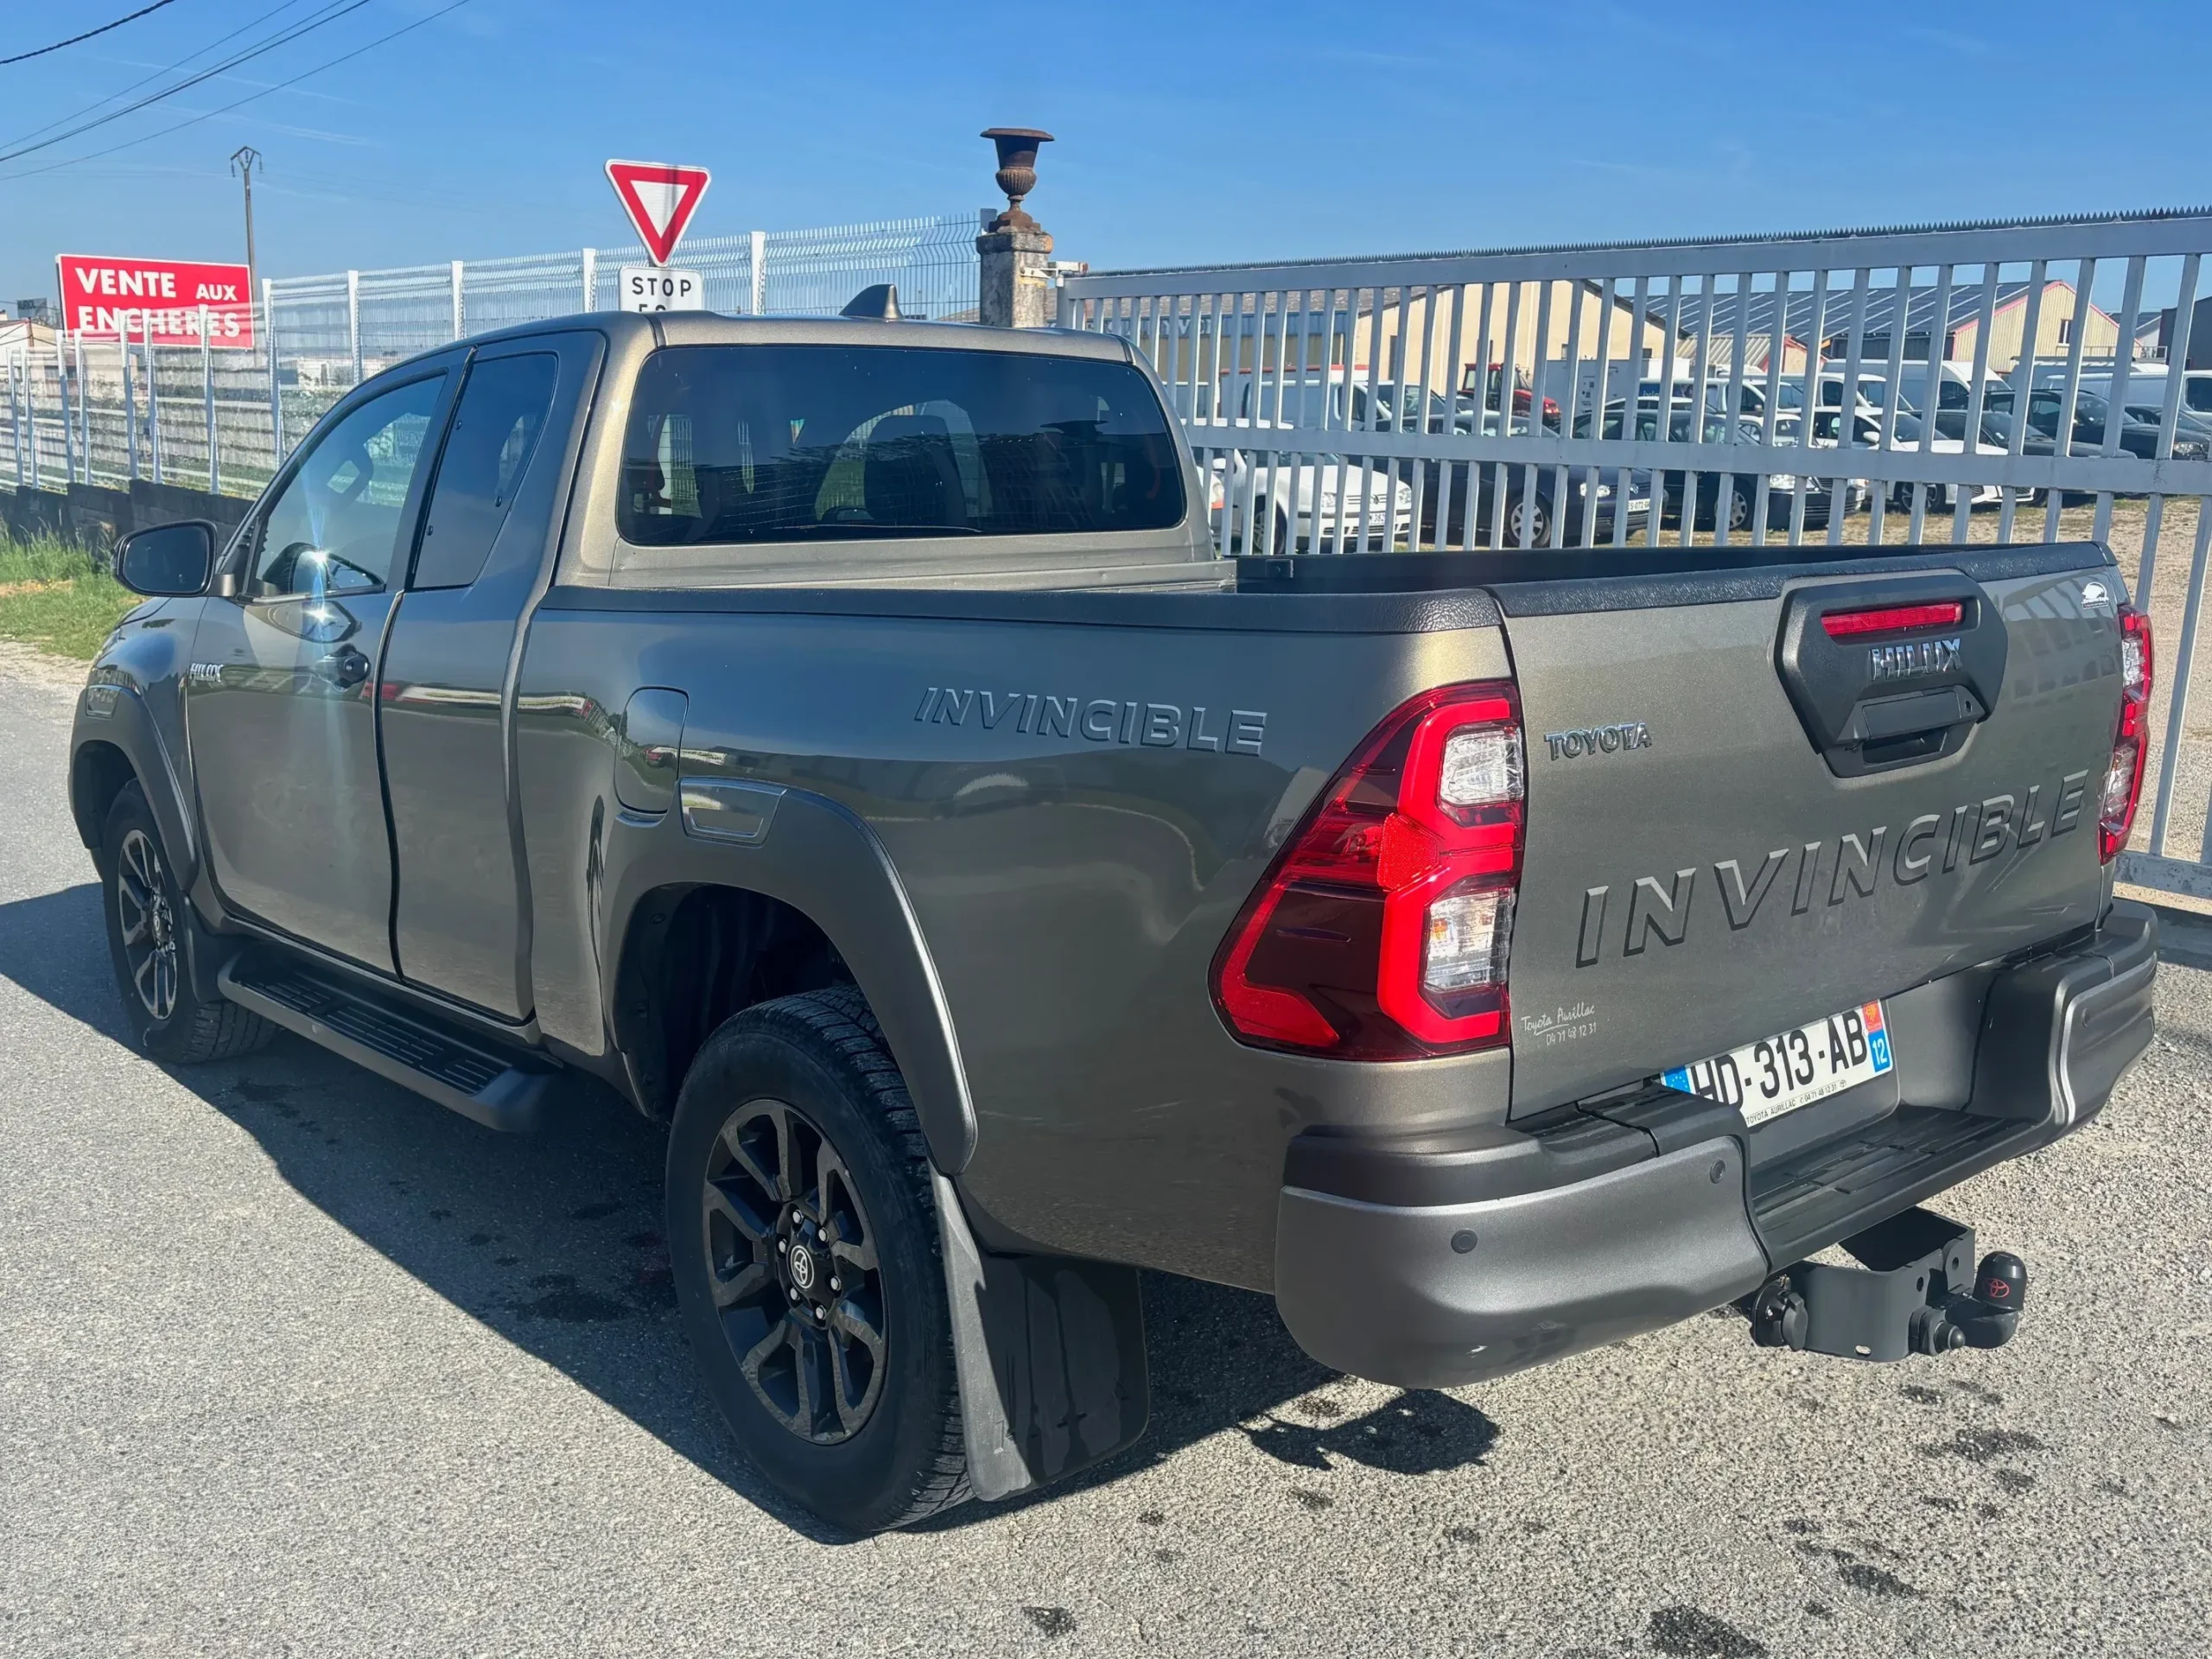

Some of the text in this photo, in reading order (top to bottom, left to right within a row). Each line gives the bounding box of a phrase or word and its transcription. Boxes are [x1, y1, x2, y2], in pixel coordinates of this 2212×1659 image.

[75, 267, 238, 302] VENTE AUX
[632, 276, 691, 297] STOP
[78, 305, 241, 338] ENCHERES
[1869, 638, 1963, 681] HILUX
[914, 686, 1268, 758] INVINCIBLE
[1543, 721, 1653, 761] TOYOTA
[1576, 769, 2088, 969] INVINCIBLE
[1521, 1001, 1595, 1035] Toyota Aurillac
[1691, 1010, 1868, 1110] HD-313-AB
[1872, 1038, 1888, 1065] 12
[1745, 1110, 1769, 1125] TOYOTA
[1770, 1099, 1796, 1115] AURILLAC
